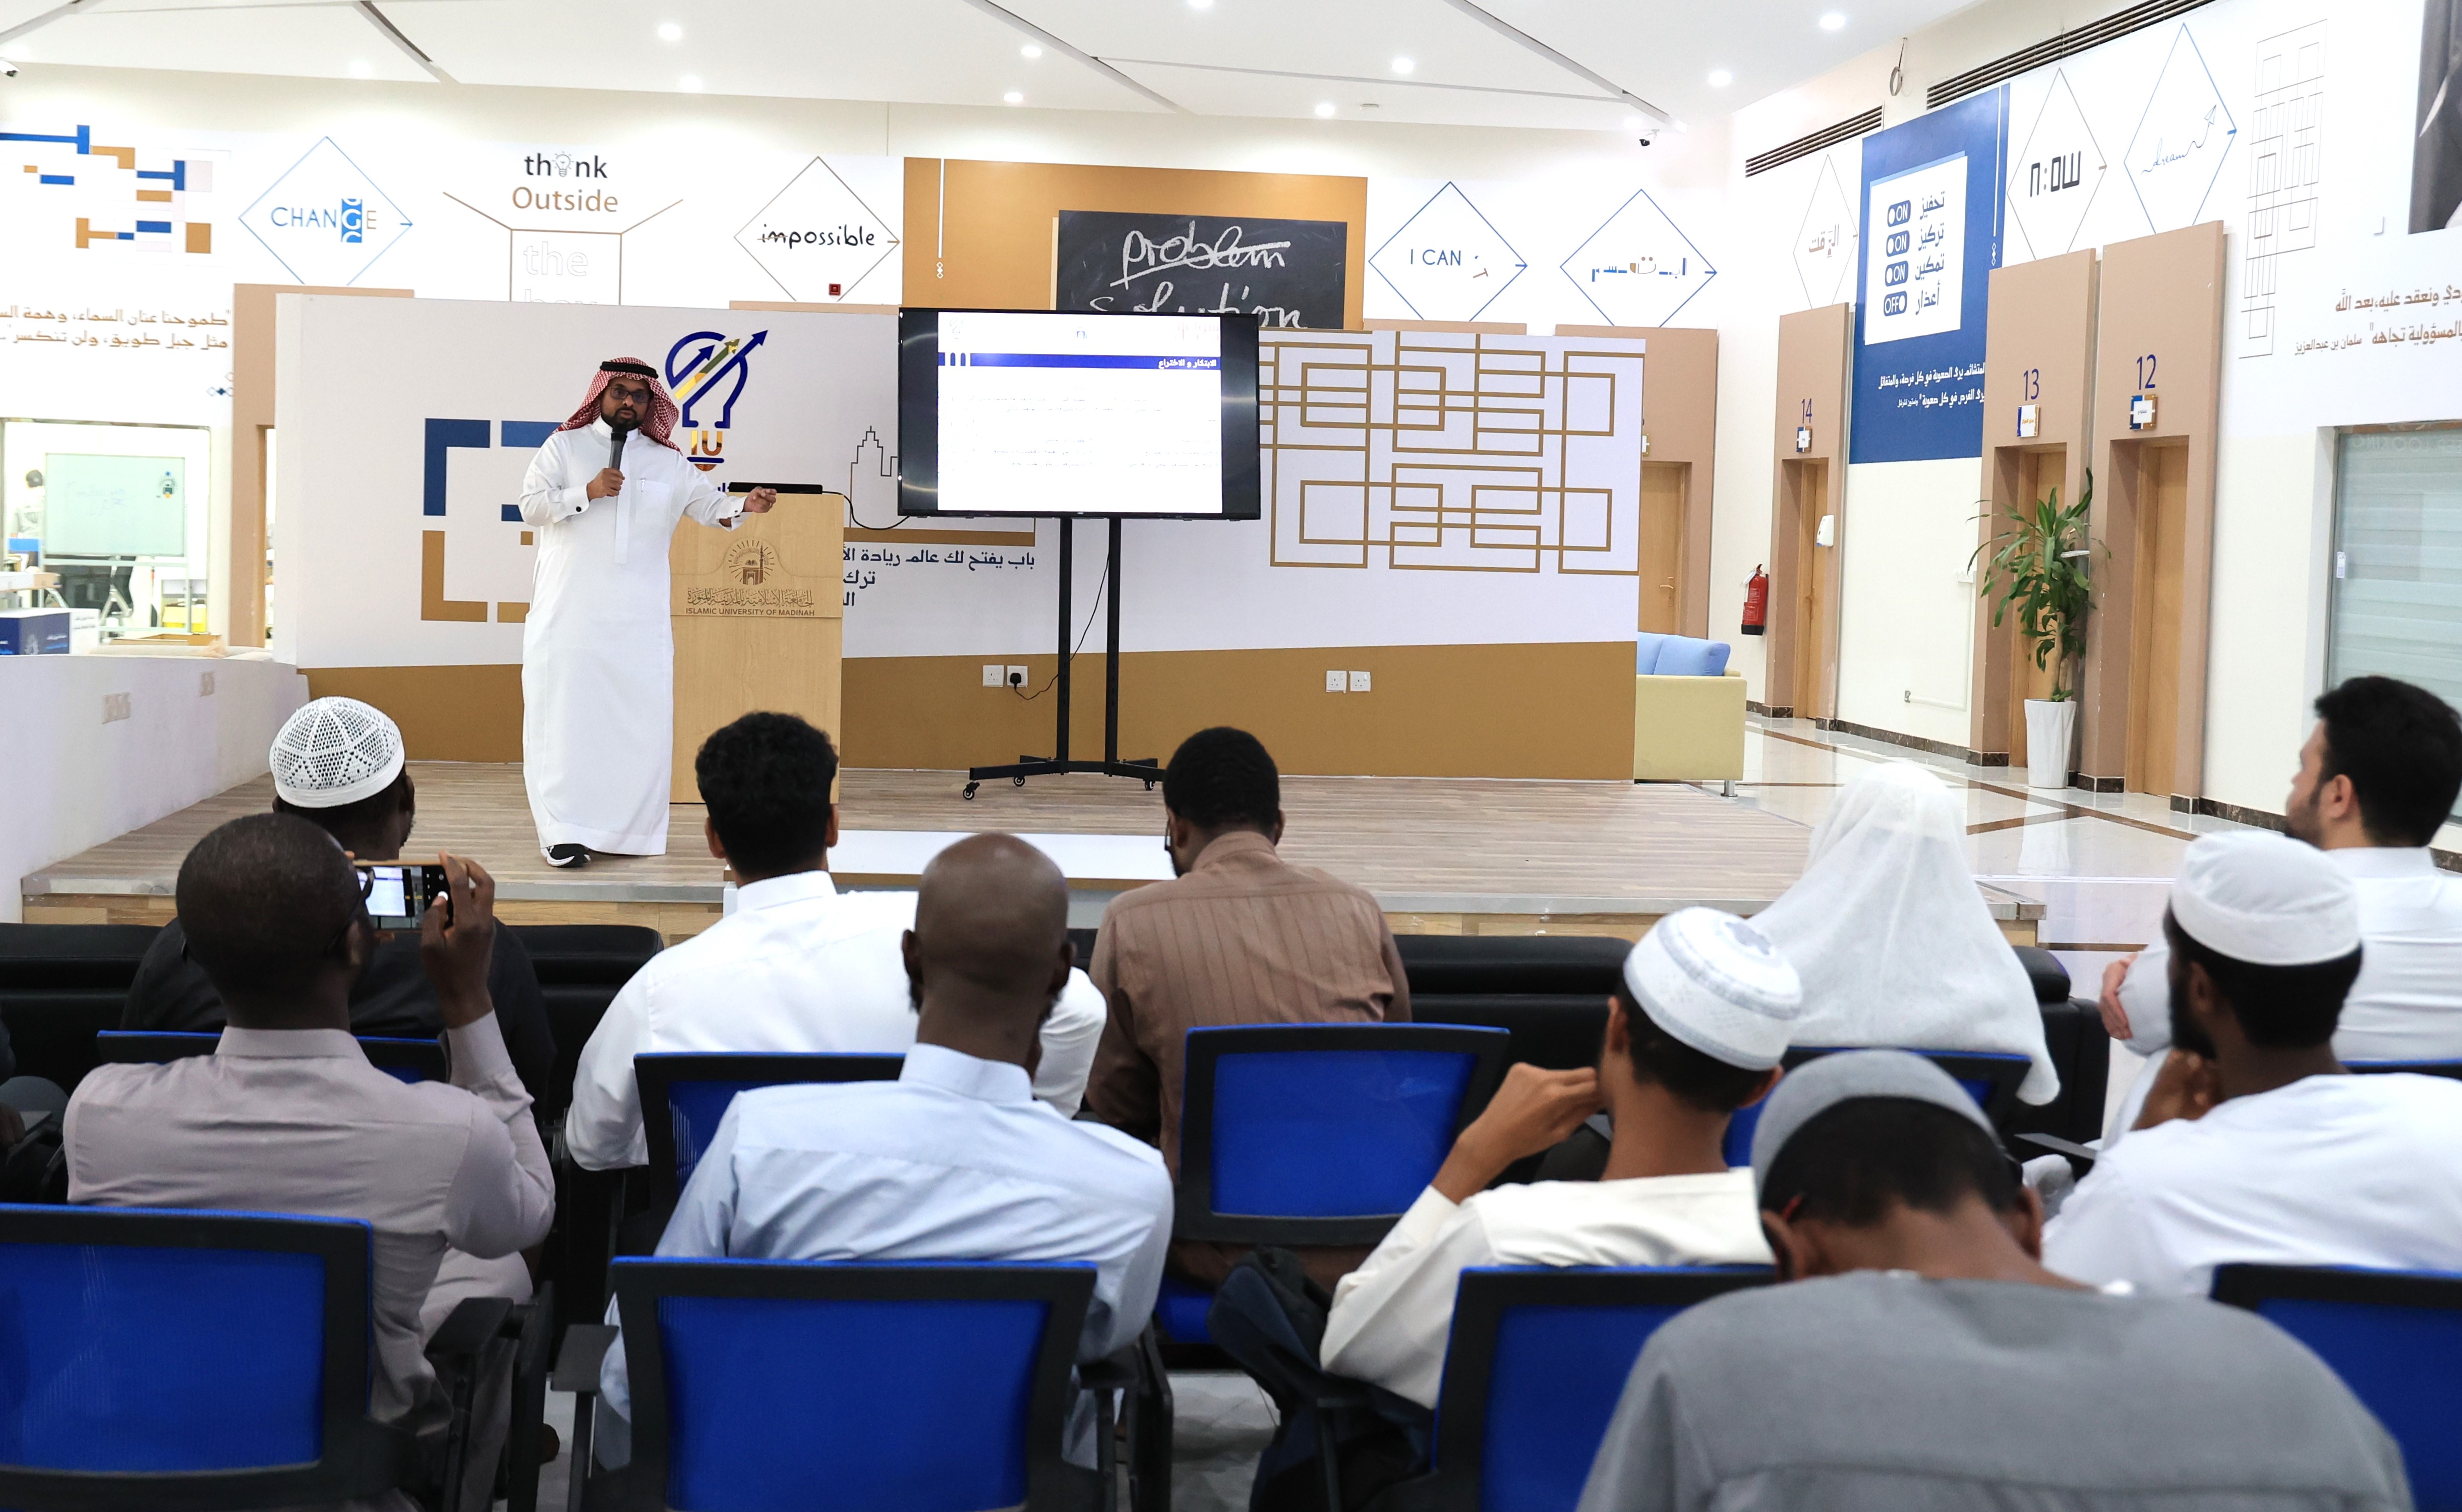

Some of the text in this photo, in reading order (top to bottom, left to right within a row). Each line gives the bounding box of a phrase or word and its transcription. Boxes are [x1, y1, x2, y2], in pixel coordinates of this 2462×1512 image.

[512, 186, 619, 213] Outside
[1919, 191, 1945, 220] تحفيز
[271, 205, 377, 231] CHANGE
[1896, 203, 1908, 221] ON
[759, 224, 875, 249] impossible
[1895, 234, 1907, 252] ON
[1918, 222, 1945, 251] تركيز
[523, 241, 589, 277] the
[1116, 220, 1289, 290] problem
[1411, 249, 1413, 265] I
[1893, 264, 1906, 282] ON
[1915, 253, 1945, 280] تمكين
[1915, 279, 1941, 315] أعذار
[2443, 284, 2462, 306] دي
[1884, 296, 1899, 314] OFF
[2330, 339, 2339, 350] بن
[2340, 334, 2362, 349] سلمان
[1158, 358, 1185, 370] الاختراع
[1192, 358, 1217, 369] الابتكار
[1964, 361, 1985, 376] لمتشائم
[2136, 354, 2157, 390] 12
[1915, 370, 1924, 385] كل
[1924, 370, 1932, 387] في
[2023, 368, 2039, 401] 13
[1939, 391, 1949, 406] كل
[1949, 391, 1957, 408] في
[1801, 398, 1812, 424] 14
[843, 543, 1035, 571] باب يفتح لك عالم ريادة الأ
[843, 591, 855, 607] ال
